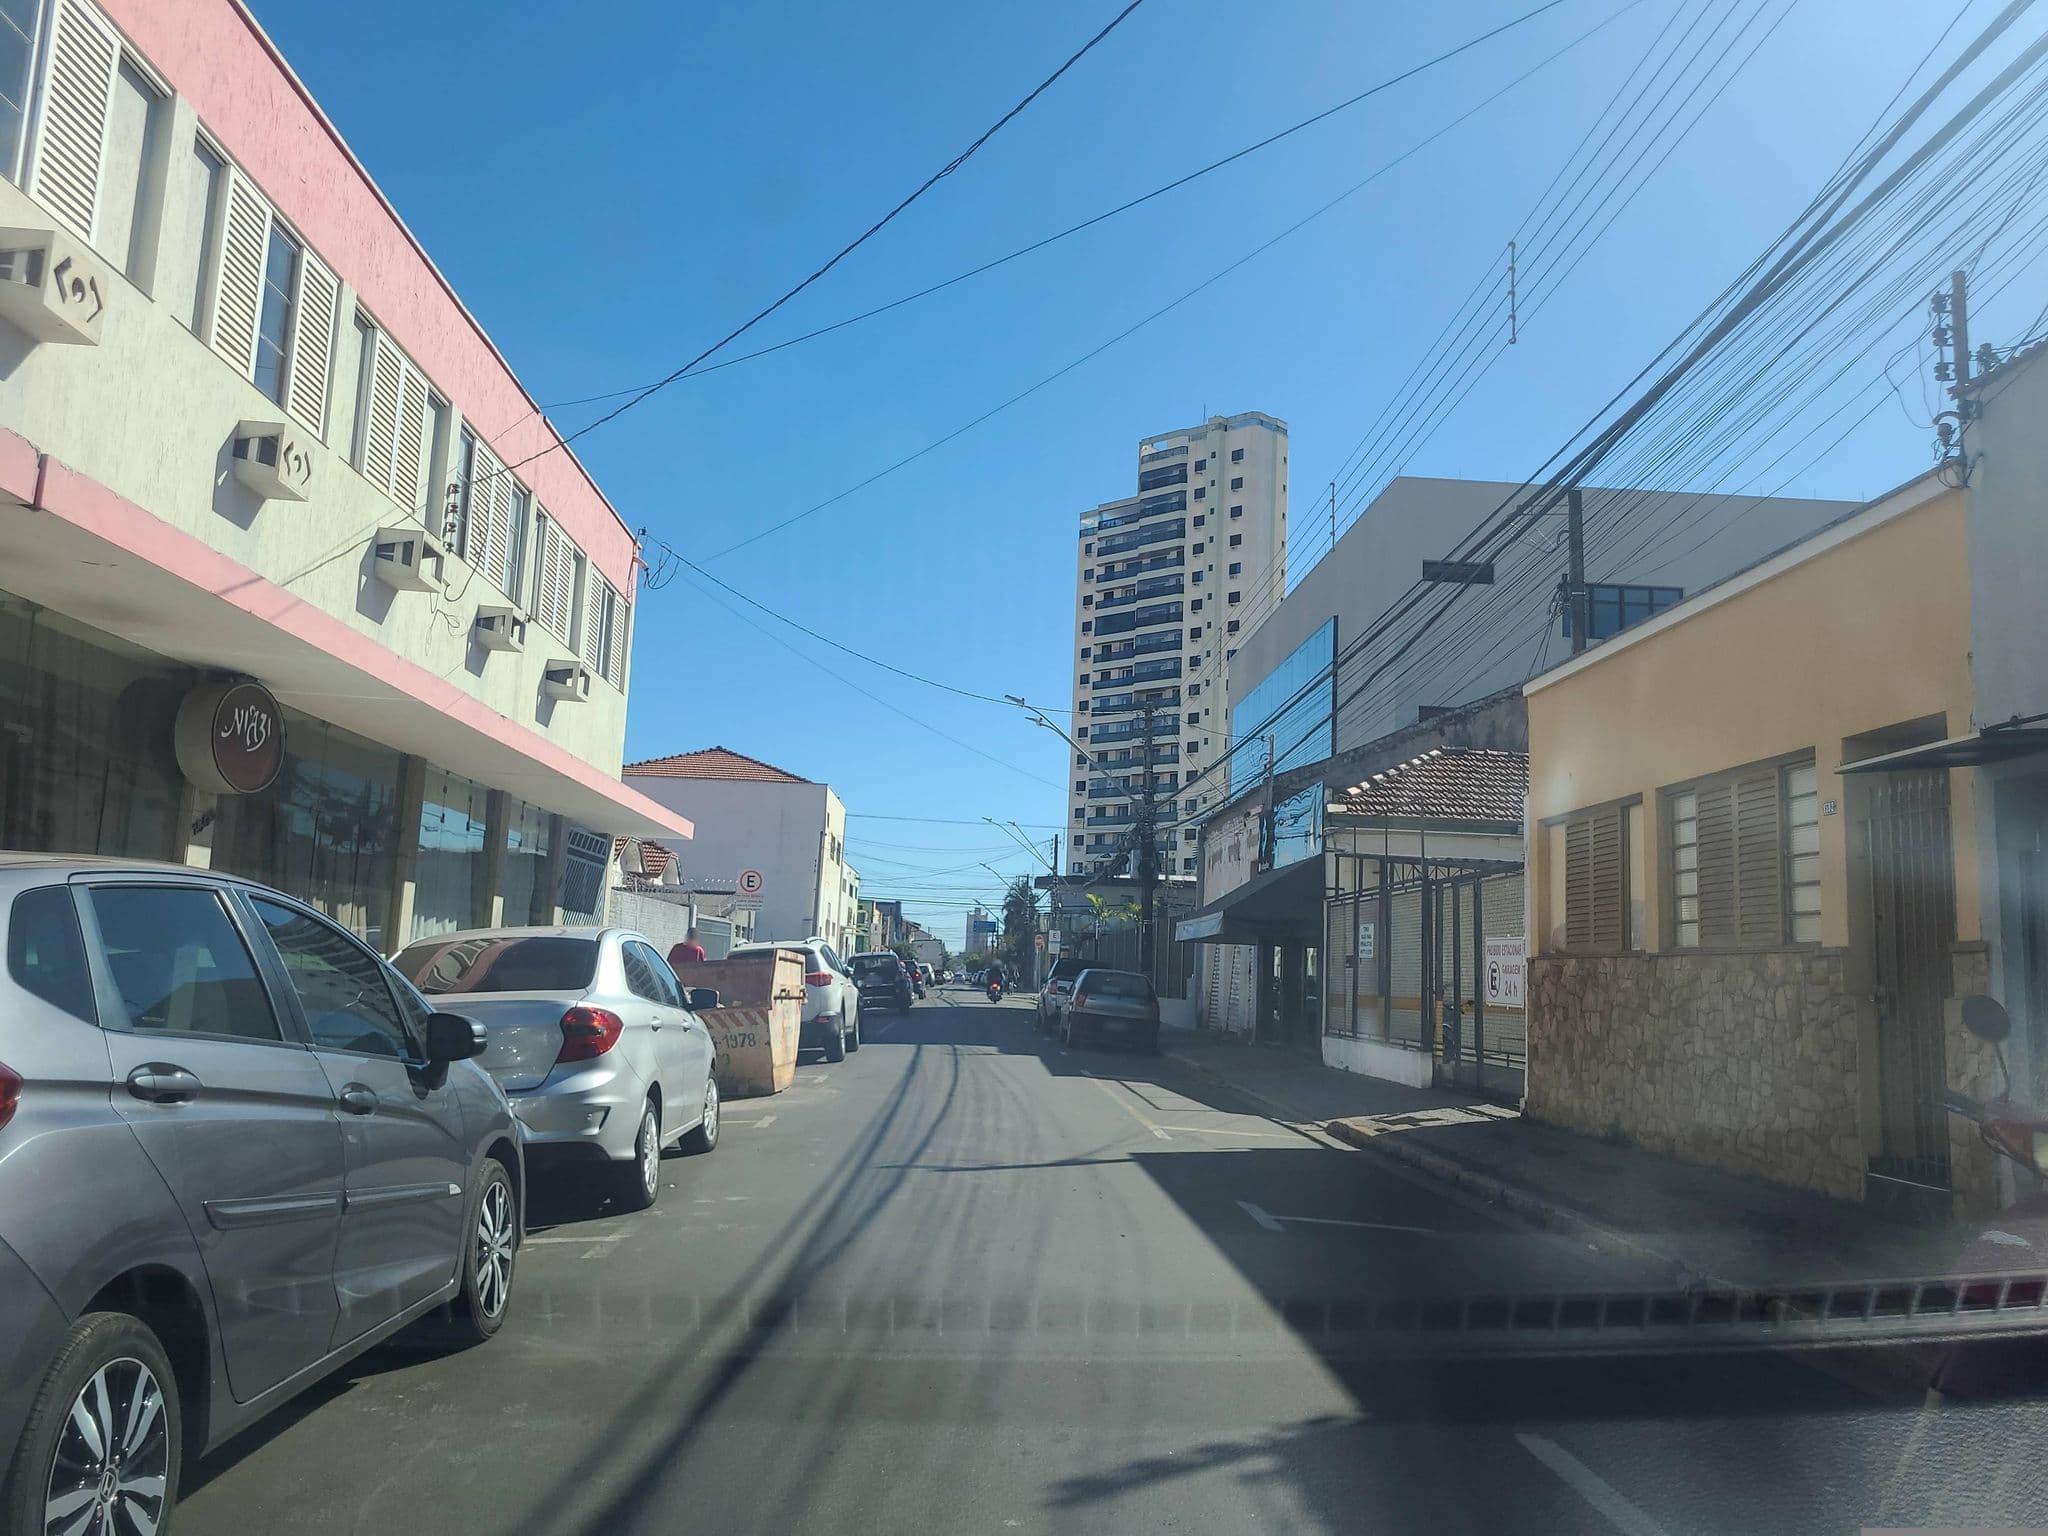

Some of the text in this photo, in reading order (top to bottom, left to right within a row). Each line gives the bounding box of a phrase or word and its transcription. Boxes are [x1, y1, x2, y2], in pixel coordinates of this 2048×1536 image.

[747, 875, 756, 888] E
[1490, 968, 1498, 990] E
[1504, 980, 1512, 997] 24
